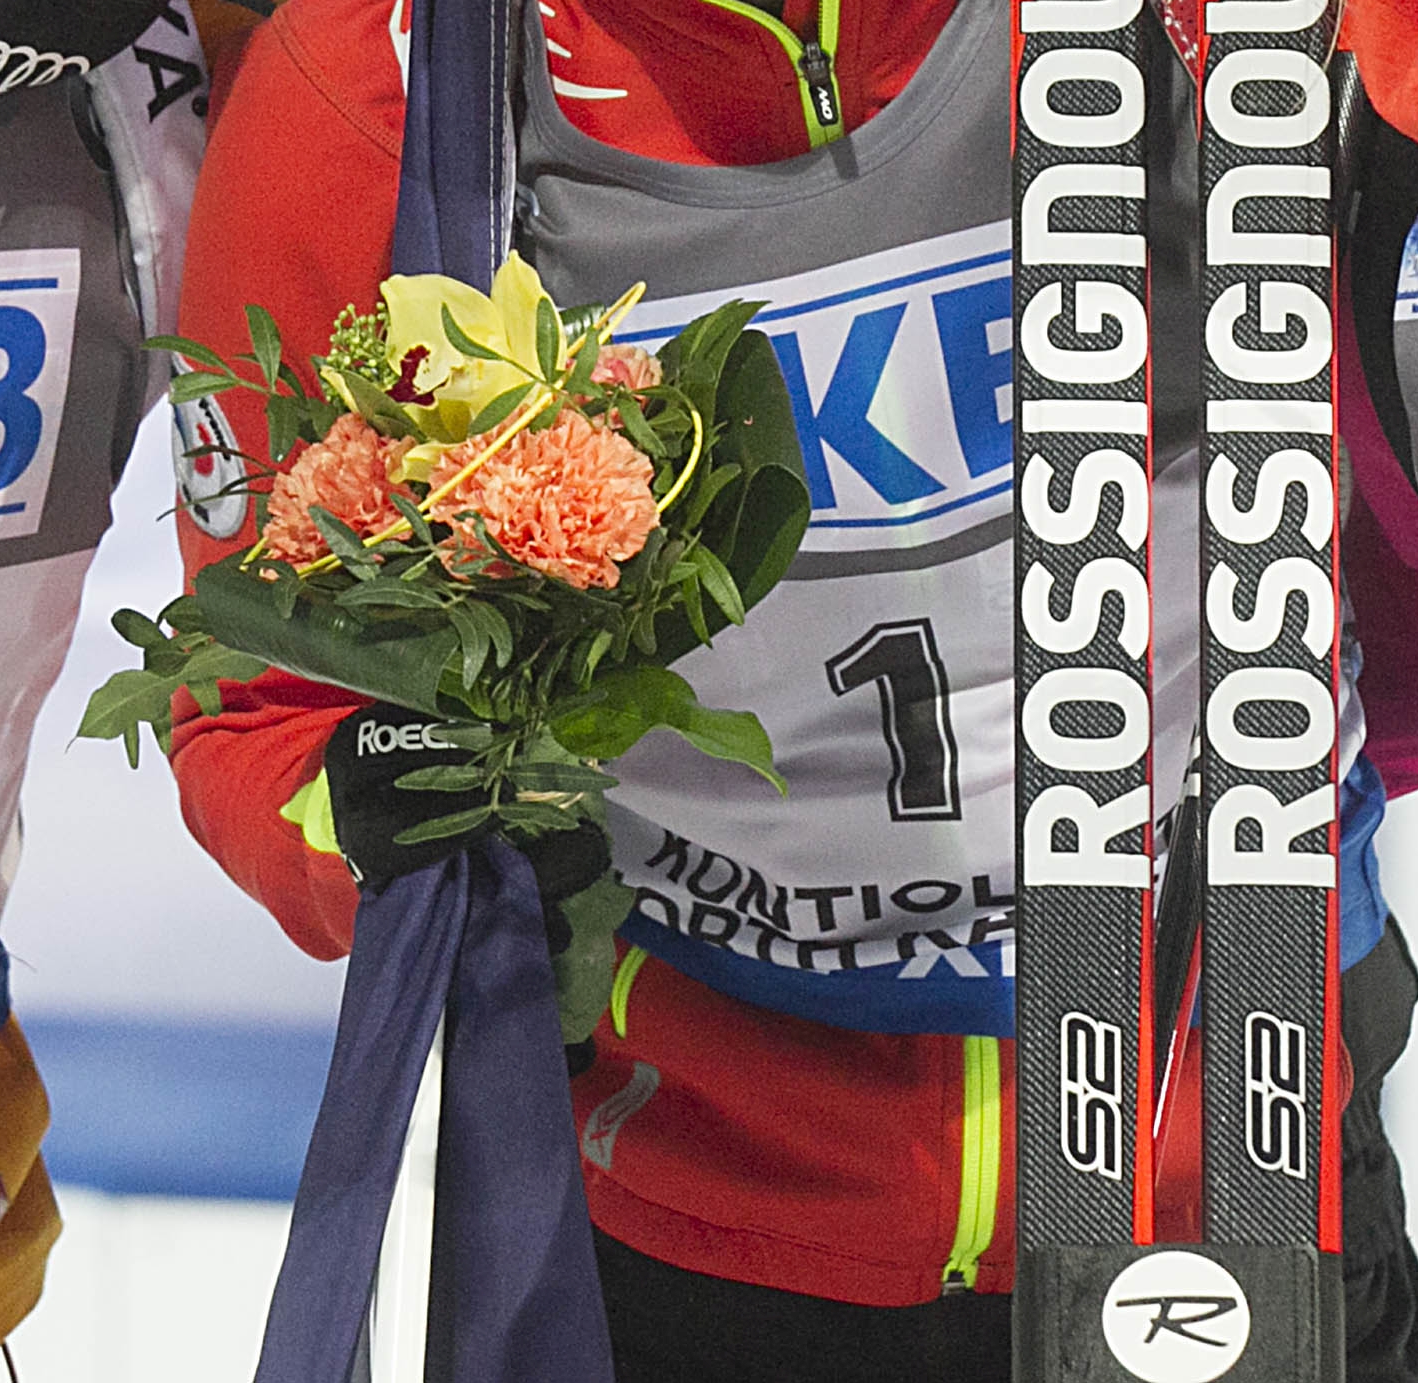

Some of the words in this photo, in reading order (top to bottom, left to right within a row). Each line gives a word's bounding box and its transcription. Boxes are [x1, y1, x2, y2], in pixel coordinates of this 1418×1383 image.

[768, 276, 1015, 510] KB
[824, 617, 962, 822] 1
[645, 829, 1015, 933] KONTIOL
